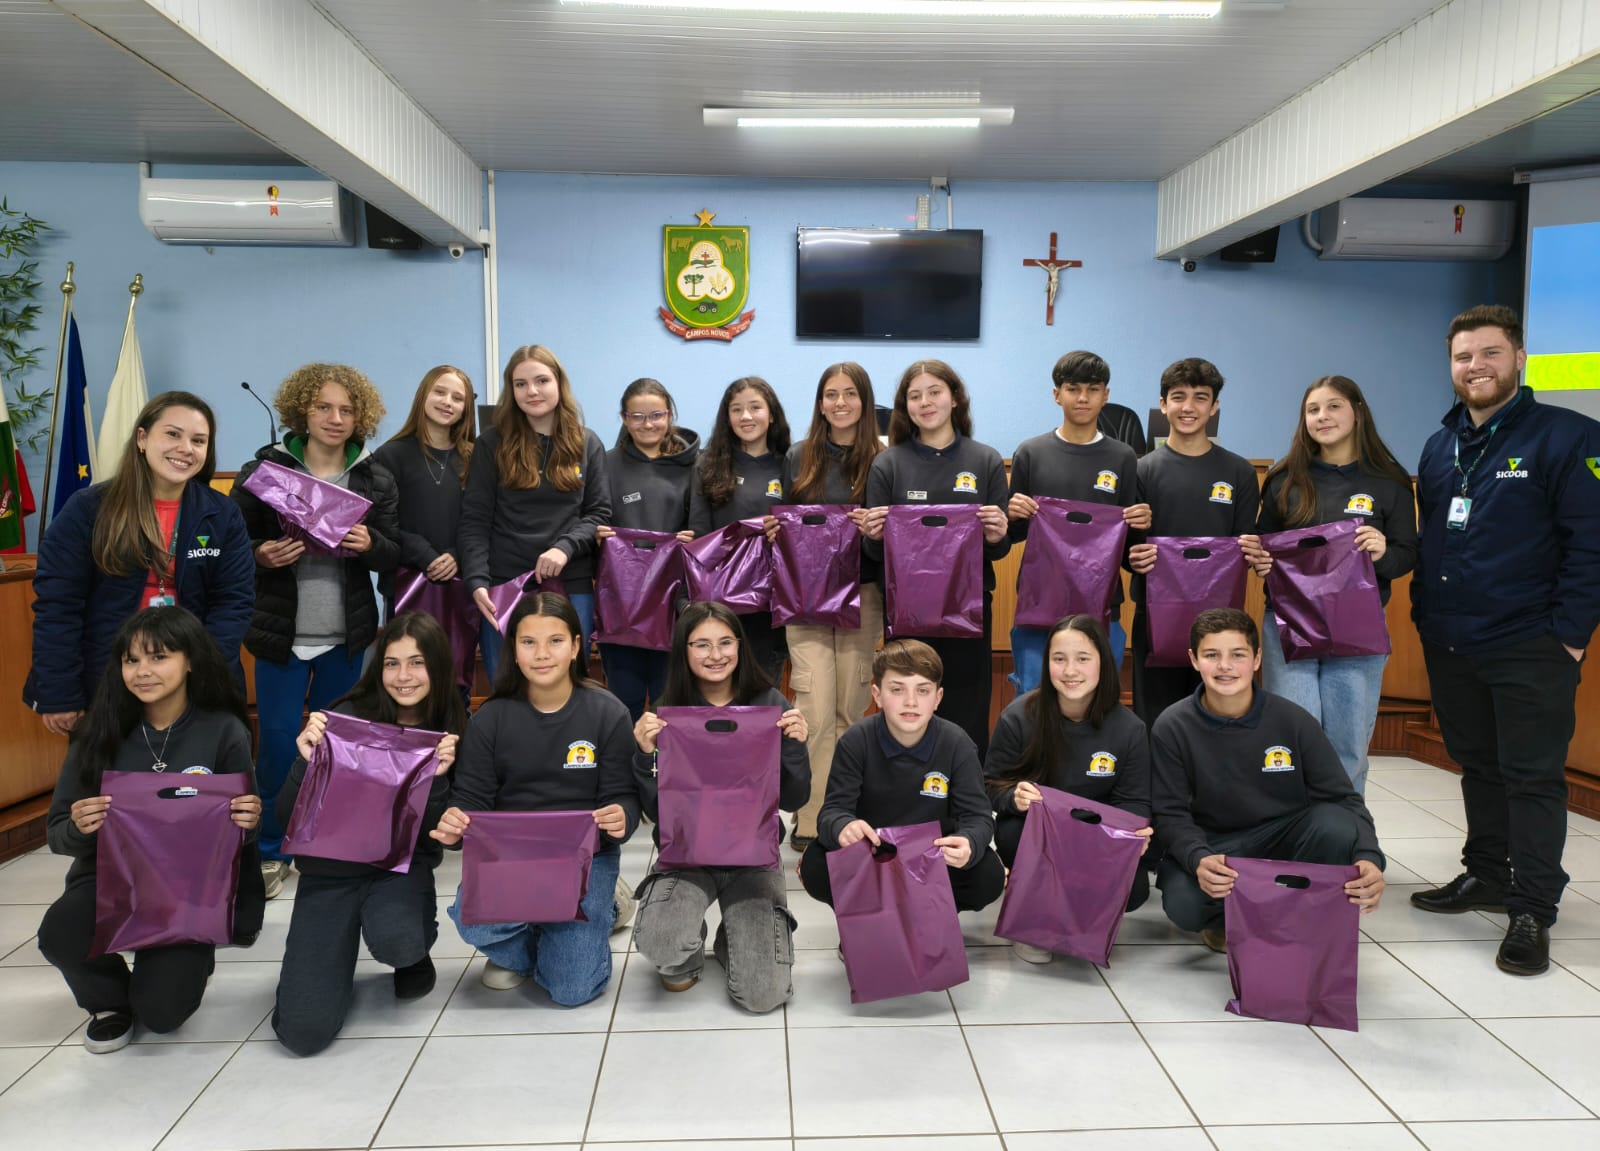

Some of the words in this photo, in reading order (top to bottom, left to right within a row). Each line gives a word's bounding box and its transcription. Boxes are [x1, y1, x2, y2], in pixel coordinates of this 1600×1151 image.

[685, 329, 710, 339] CAMPOS
[710, 329, 730, 339] NOVOS
[1495, 470, 1529, 479] SICOOB
[187, 548, 221, 559] SICOOB
